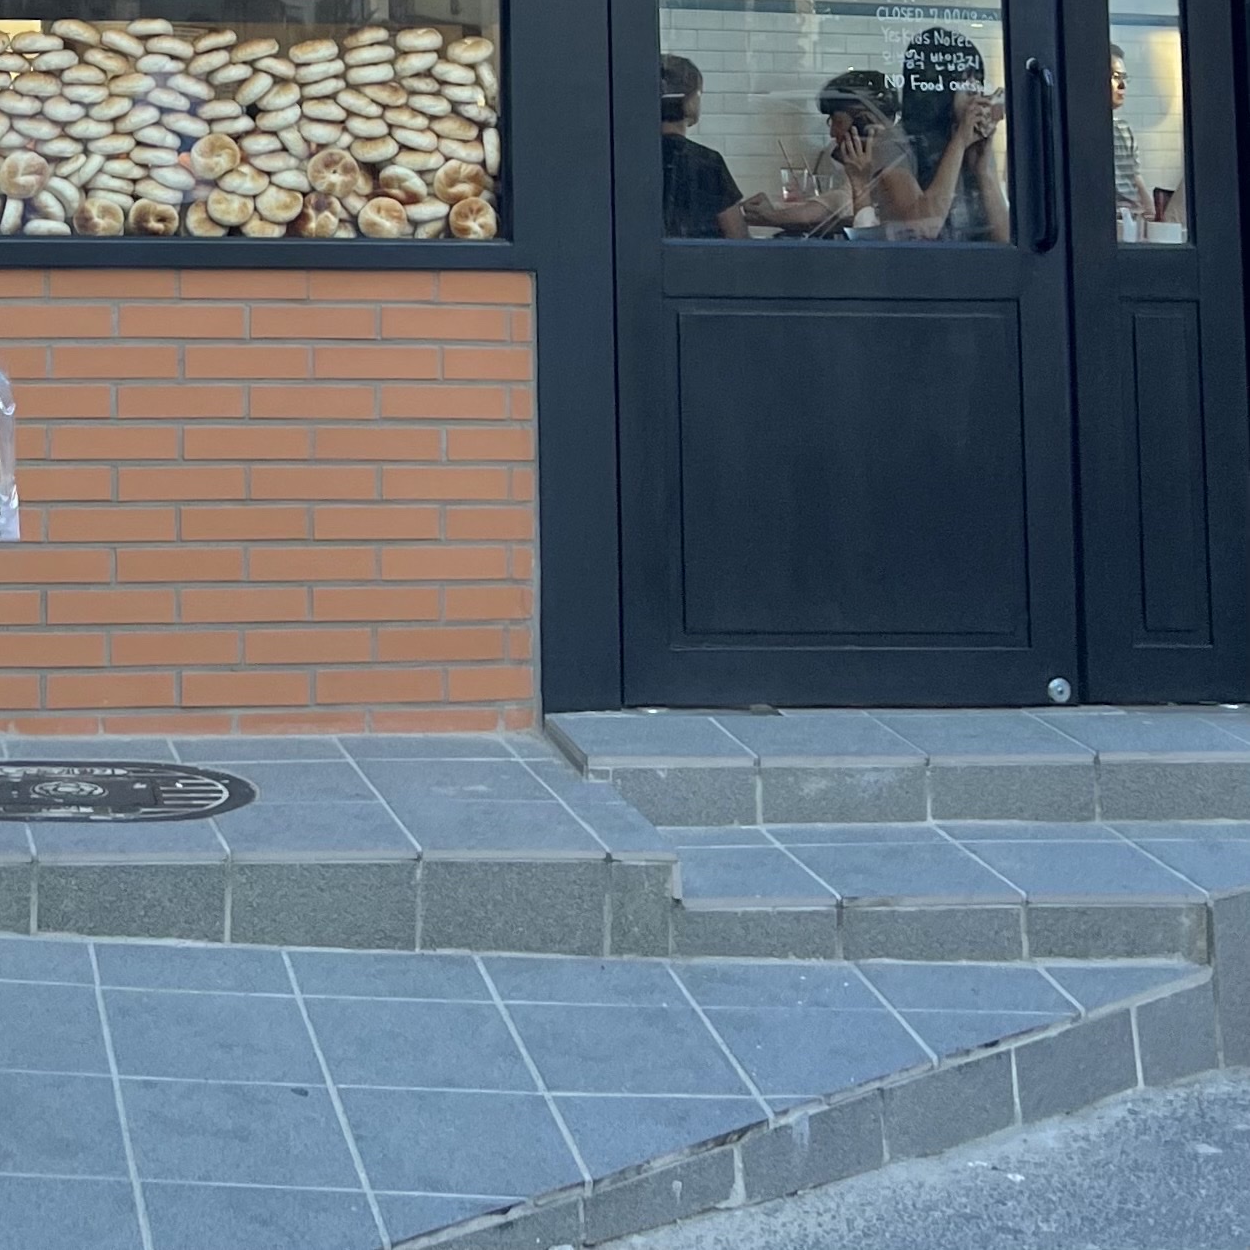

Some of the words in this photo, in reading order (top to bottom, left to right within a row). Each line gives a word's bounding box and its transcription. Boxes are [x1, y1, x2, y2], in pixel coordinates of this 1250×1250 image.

[876, 6, 924, 22] CLOSED
[883, 73, 906, 89] NO
[910, 74, 944, 91] Food
